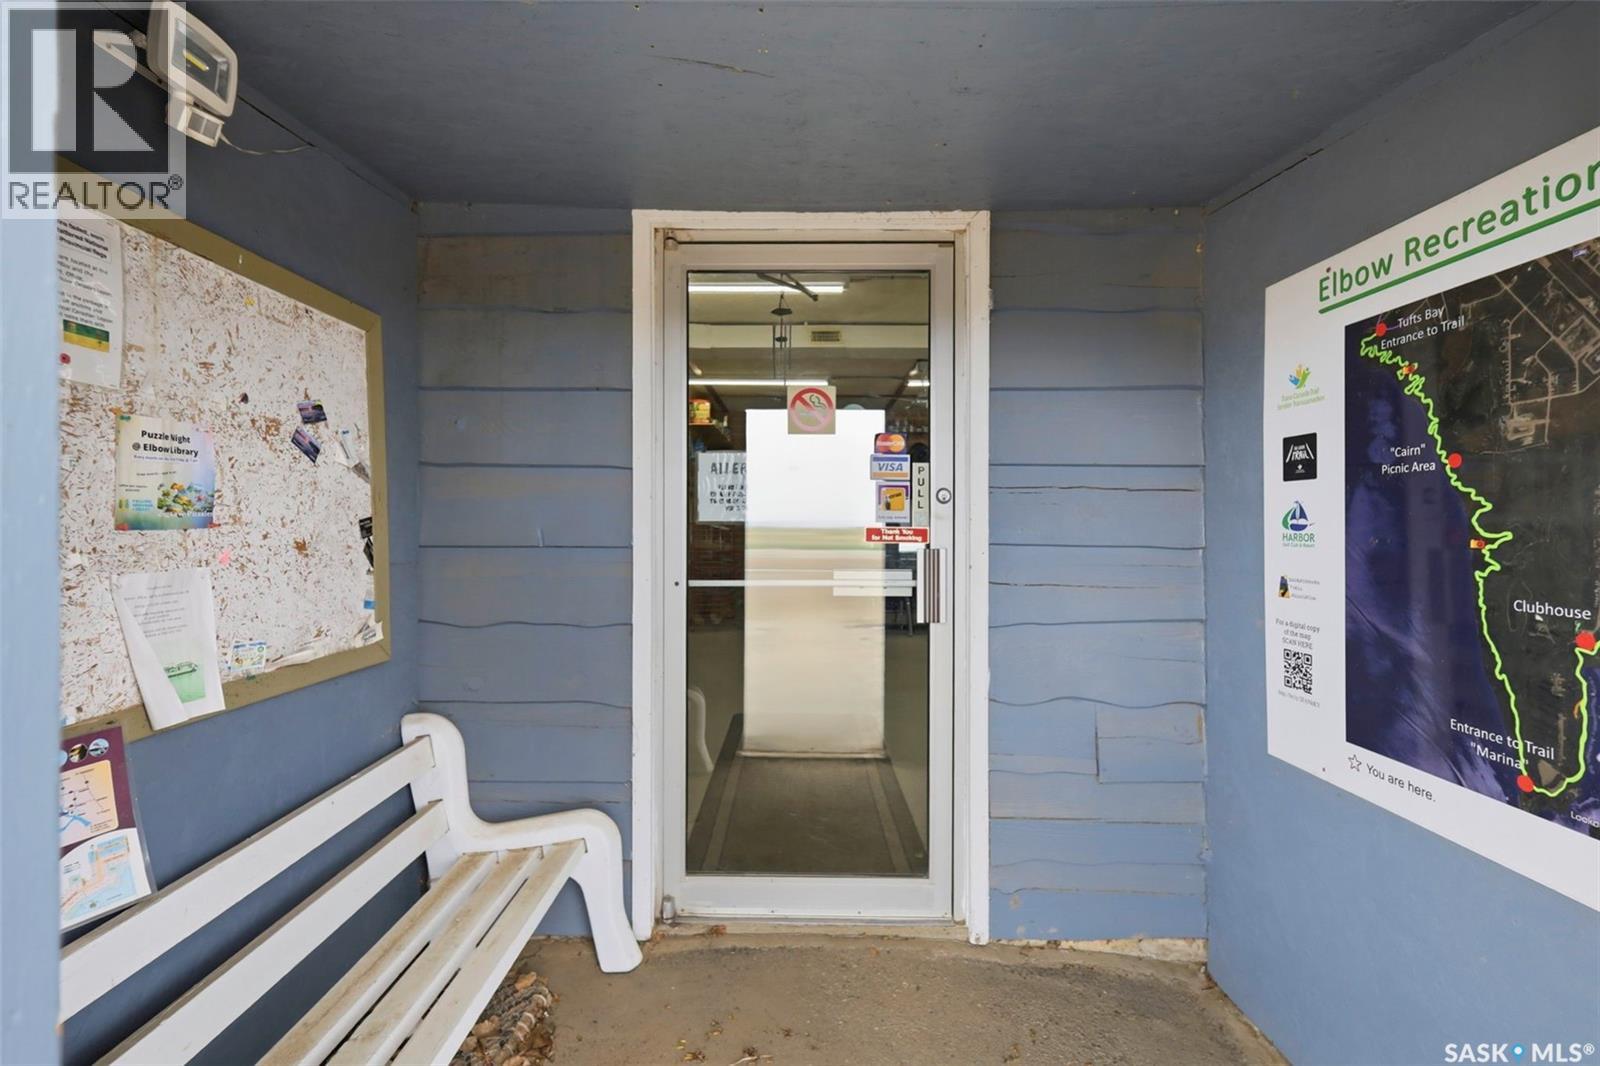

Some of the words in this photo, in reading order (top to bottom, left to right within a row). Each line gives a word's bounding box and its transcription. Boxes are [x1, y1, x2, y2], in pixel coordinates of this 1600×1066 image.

[1319, 253, 1393, 303] Elbow
[1398, 313, 1422, 328] Tufts
[1425, 305, 1445, 320] Bay
[1380, 329, 1425, 350] Entrance
[1426, 321, 1438, 333] to
[1441, 314, 1466, 330] Trail
[141, 430, 170, 441] Puzzle
[170, 433, 191, 444] Night
[143, 443, 170, 453] Elbow
[170, 445, 199, 458] Library
[1390, 443, 1427, 458] "Cairn"
[878, 463, 904, 472] VISA
[1381, 461, 1409, 475] Picnic
[1411, 460, 1436, 472] Area
[917, 466, 925, 510] PULL
[895, 534, 923, 542] Smoking
[1282, 532, 1315, 543] HARBOR
[1513, 599, 1592, 620] Clubhouse
[1450, 717, 1503, 745] Entrance
[1506, 735, 1521, 749] to
[1524, 739, 1555, 760] Trail
[1366, 763, 1385, 781] You
[1387, 773, 1405, 789] are
[1407, 779, 1436, 802] here.
